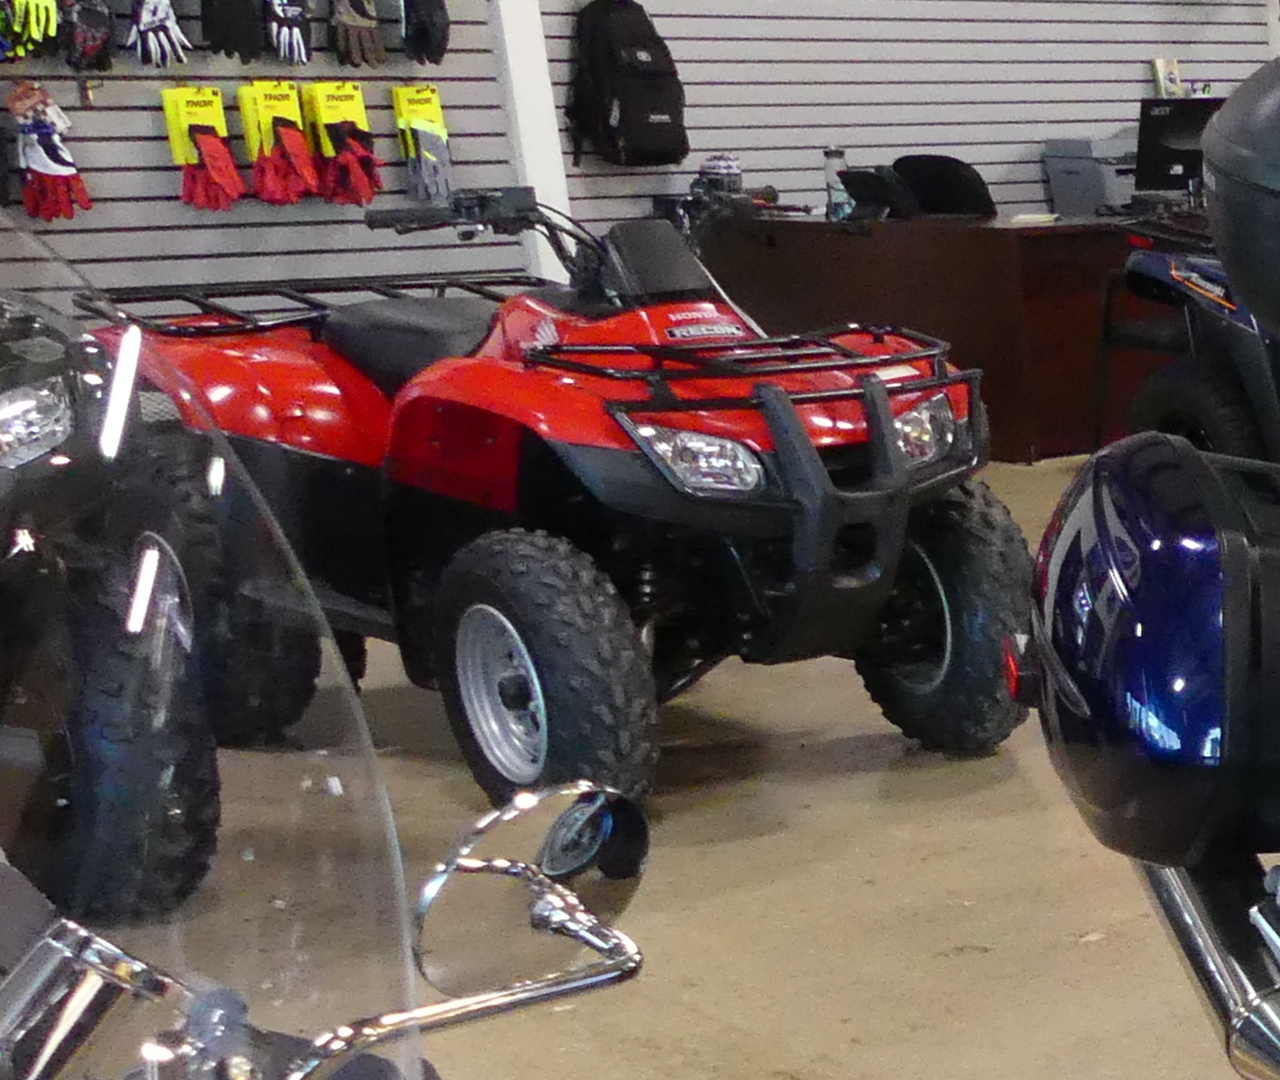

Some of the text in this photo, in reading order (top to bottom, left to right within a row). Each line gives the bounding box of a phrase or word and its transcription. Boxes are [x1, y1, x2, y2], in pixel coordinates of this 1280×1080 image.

[262, 91, 291, 103] THOR
[326, 92, 354, 104] THOR
[185, 99, 214, 110] THOR
